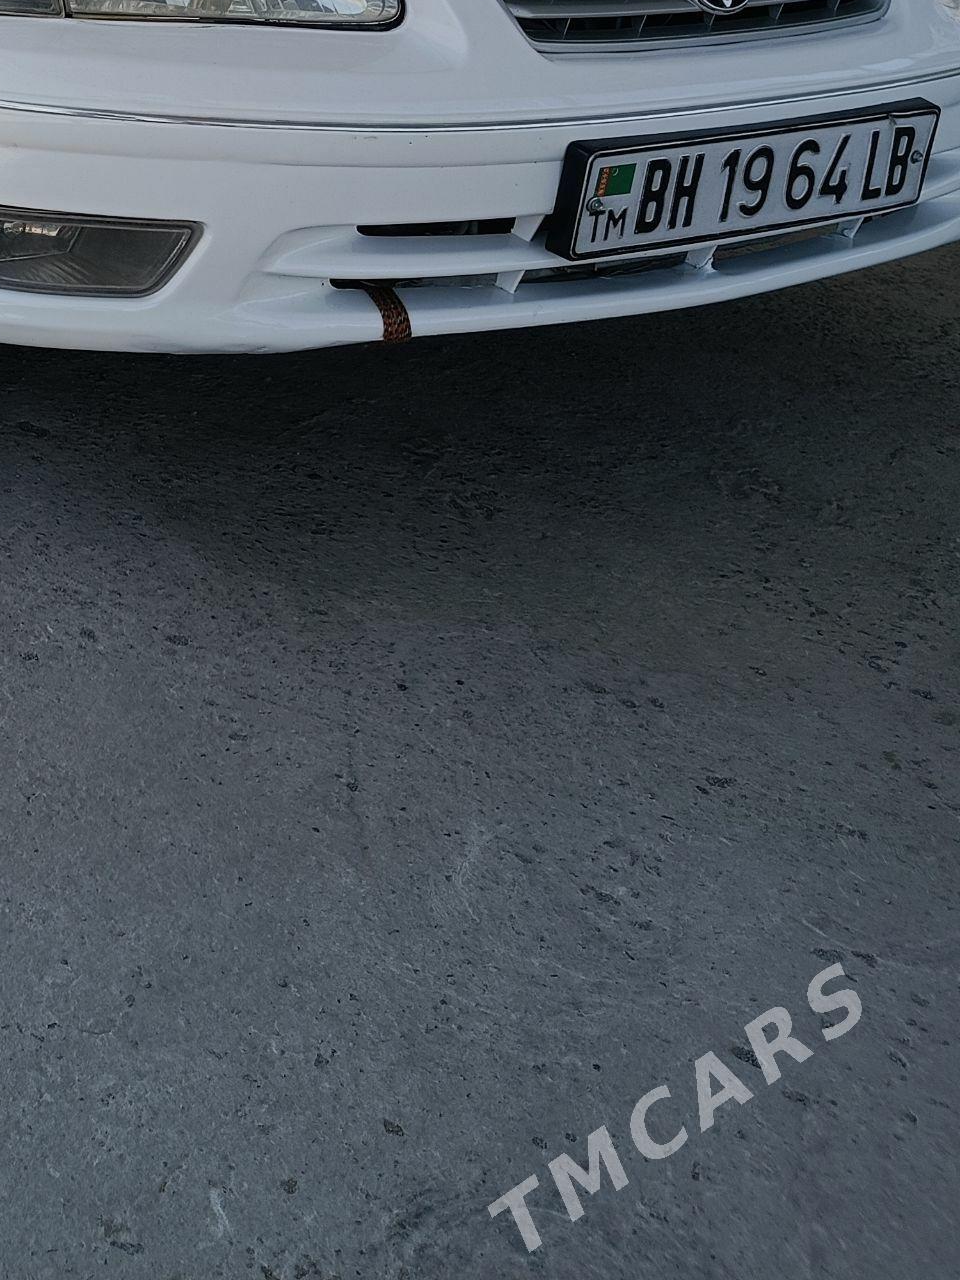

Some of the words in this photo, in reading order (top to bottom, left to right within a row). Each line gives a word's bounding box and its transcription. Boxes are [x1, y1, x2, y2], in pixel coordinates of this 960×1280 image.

[634, 153, 705, 234] BH
[860, 126, 916, 201] LB
[590, 208, 626, 243] TM
